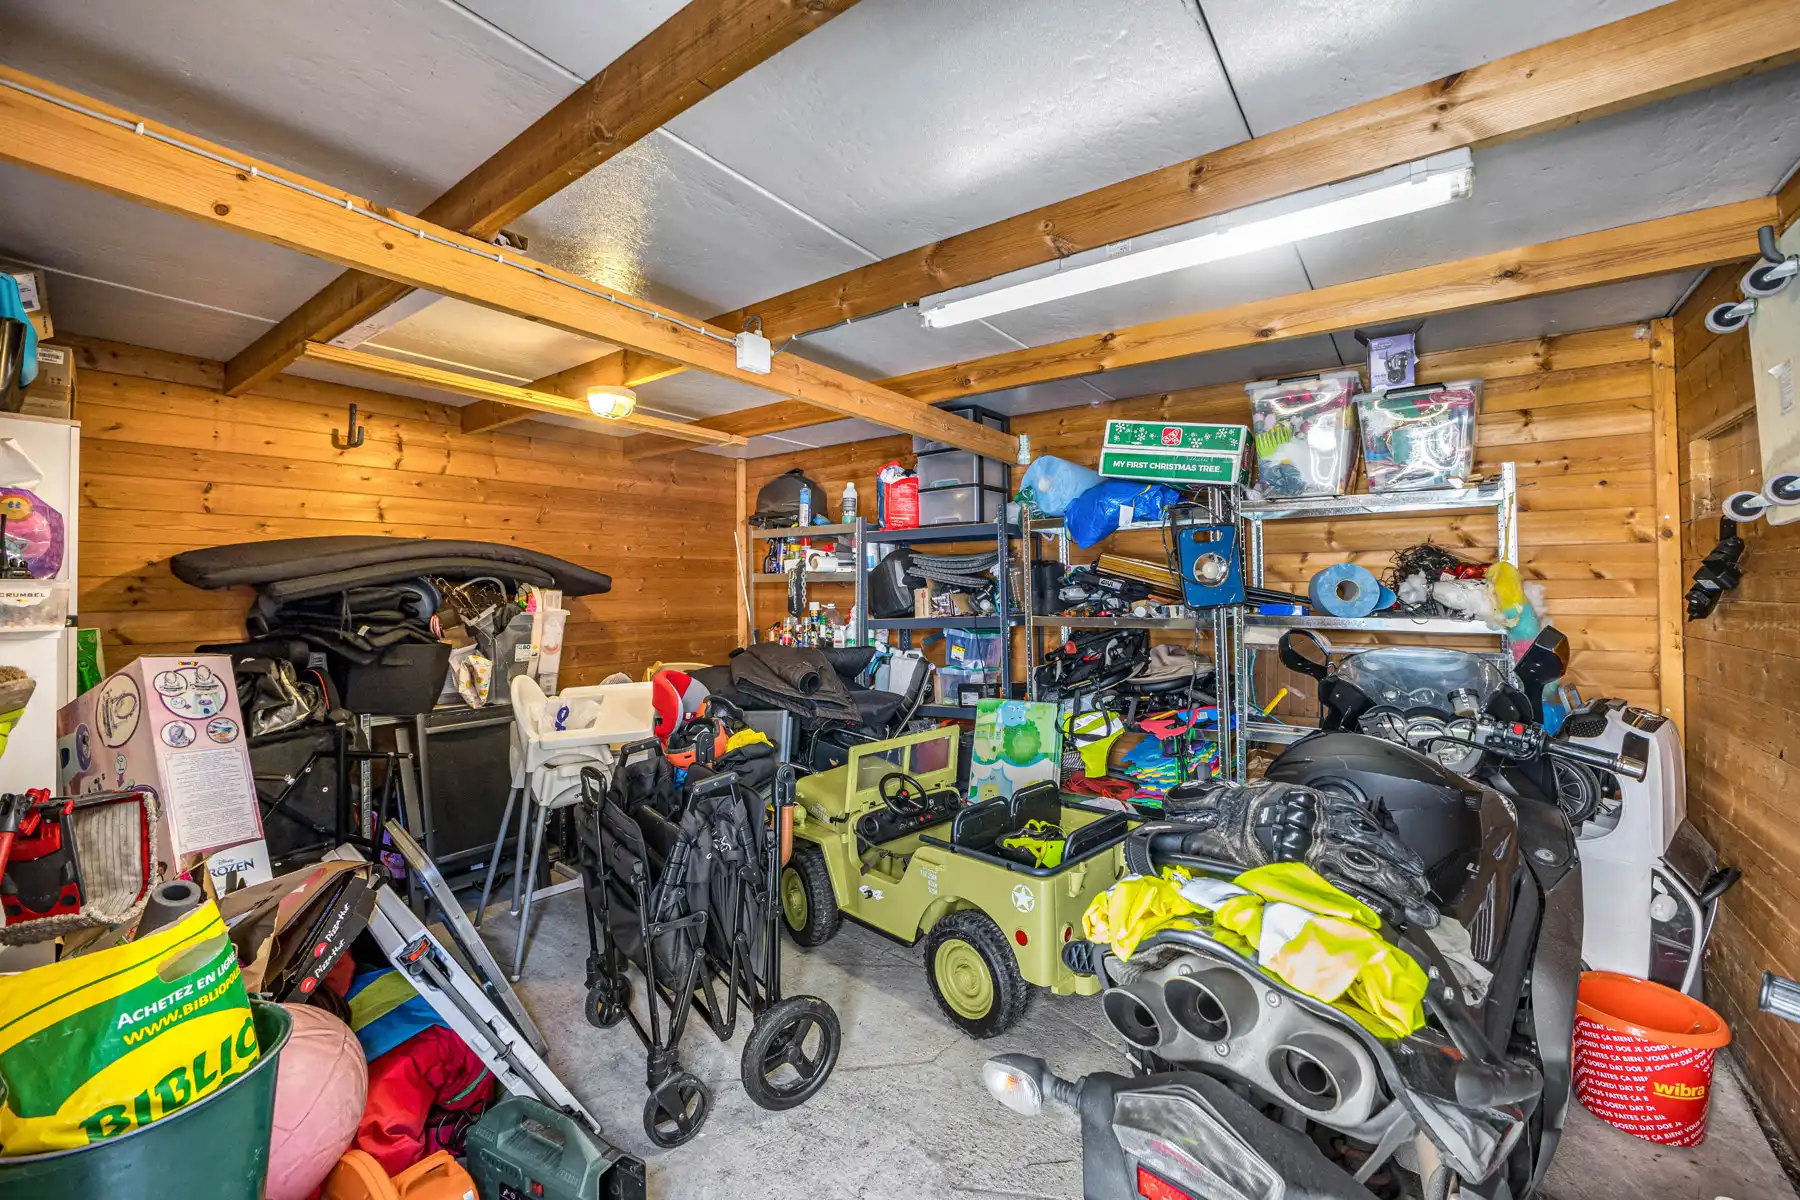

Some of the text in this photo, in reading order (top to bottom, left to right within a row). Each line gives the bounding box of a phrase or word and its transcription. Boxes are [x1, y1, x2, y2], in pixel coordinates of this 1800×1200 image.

[1113, 460, 1222, 473] MY FIRST CHRISTMAS TREE.
[208, 858, 255, 878] ROZEN
[325, 902, 351, 942] Pizza Hut
[314, 938, 346, 978] Pizza Hut
[117, 984, 194, 1031] ACHETEZ
[196, 972, 216, 990] EN
[1588, 1050, 1610, 1060] FAITES
[1610, 1054, 1621, 1062] ÇA
[1645, 1054, 1669, 1062] VOUS
[1670, 1048, 1693, 1059] FAITES
[1609, 1064, 1624, 1072] DAT
[1680, 1056, 1694, 1066] DAT
[1596, 1071, 1619, 1080] FAITES
[1618, 1084, 1634, 1092] DAT
[1653, 1082, 1705, 1097] wibra
[1605, 1091, 1629, 1100] FAITES
[1594, 1108, 1614, 1118] VOUS
[1614, 1112, 1640, 1120] FAITES
[1640, 1114, 1652, 1122] ÇA
[1628, 1104, 1644, 1112] DAT
[1651, 1134, 1662, 1142] ÇA
[1664, 1130, 1684, 1140] BIEN!
[1684, 1120, 1700, 1133] VOUS
[1656, 1121, 1673, 1130] DOE
